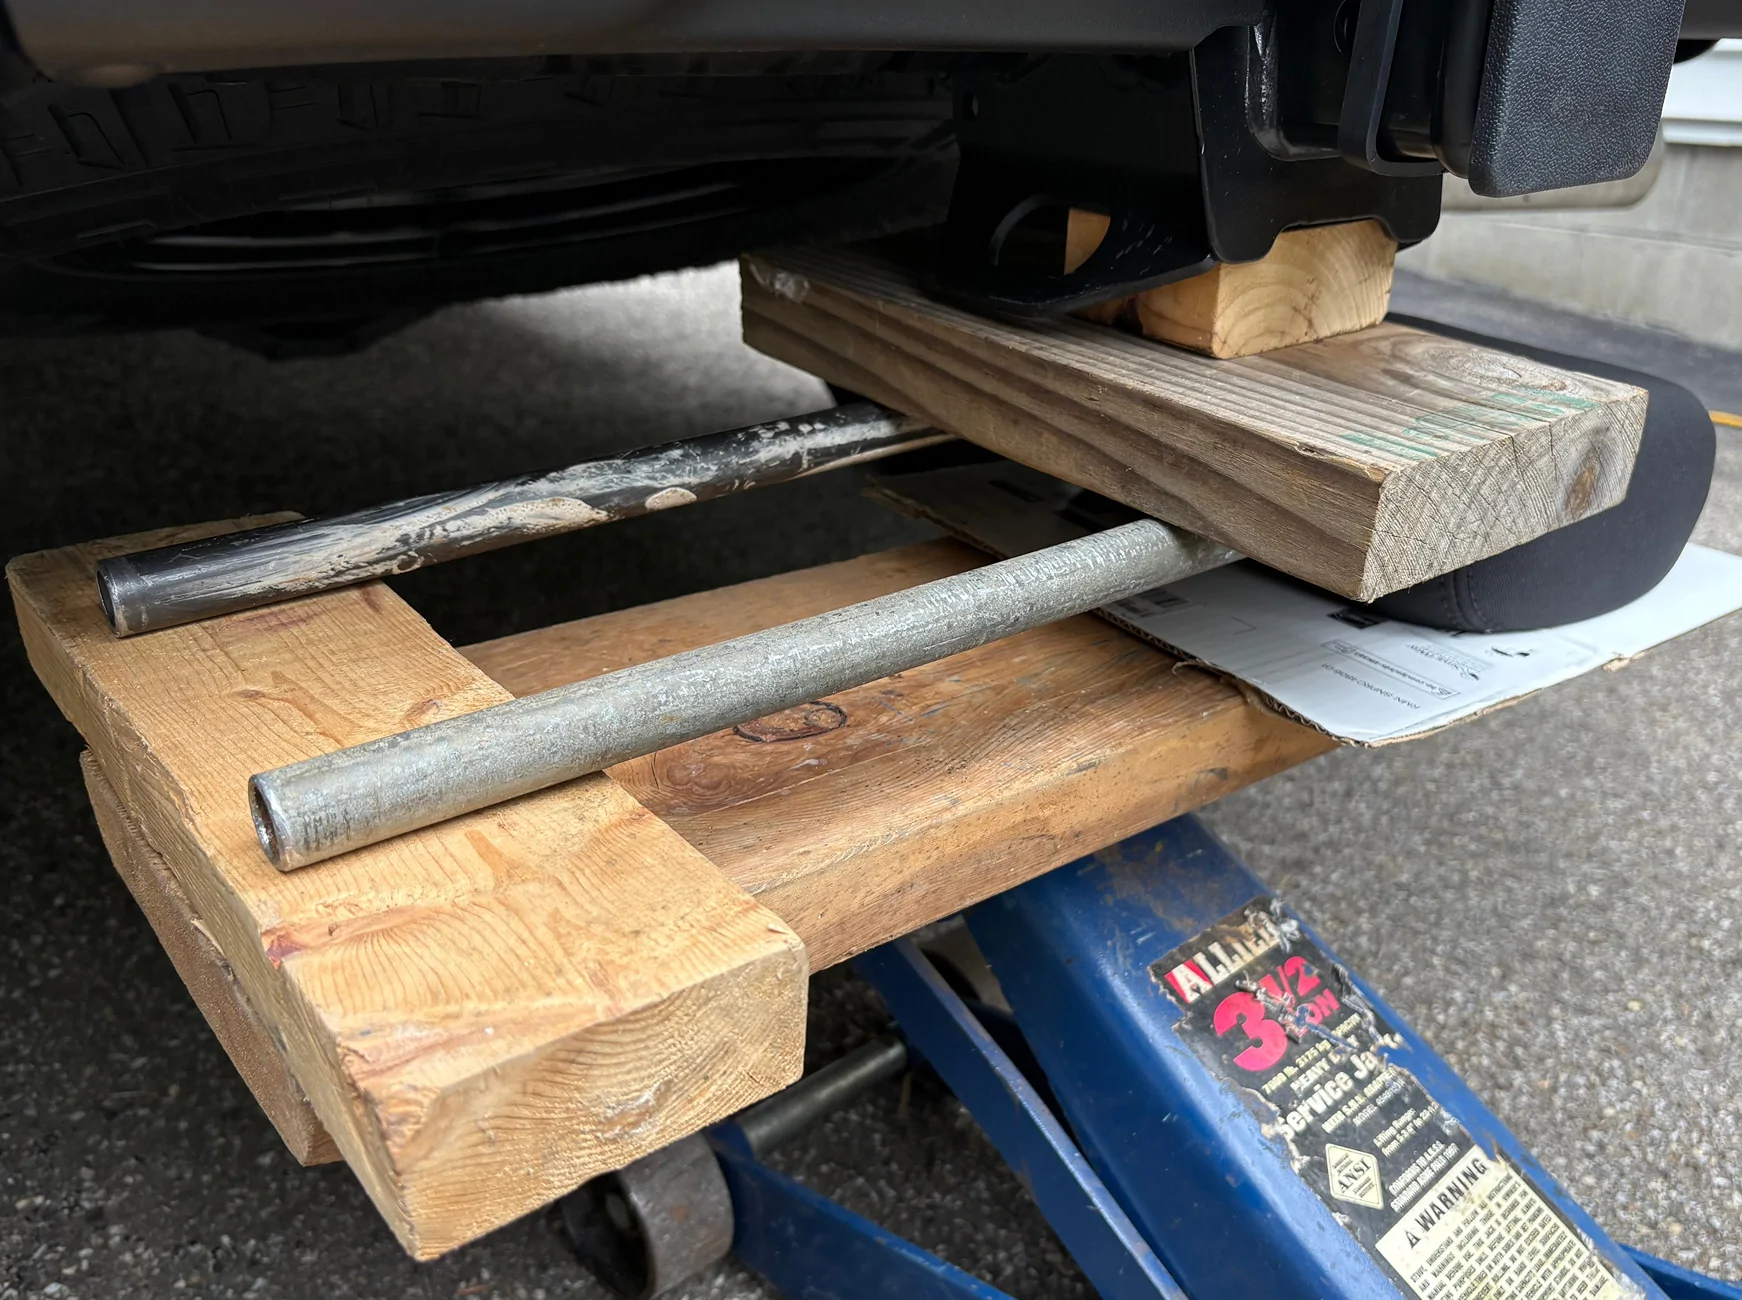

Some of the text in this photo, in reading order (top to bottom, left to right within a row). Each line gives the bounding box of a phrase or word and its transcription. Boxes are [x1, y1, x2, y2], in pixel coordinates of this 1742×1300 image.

[1213, 991, 1289, 1073] 3
[1295, 1047, 1319, 1068] 3175
[1276, 1070, 1355, 1142] Service
[1338, 1157, 1371, 1194] ANSI
[1414, 1157, 1488, 1232] WARNING
